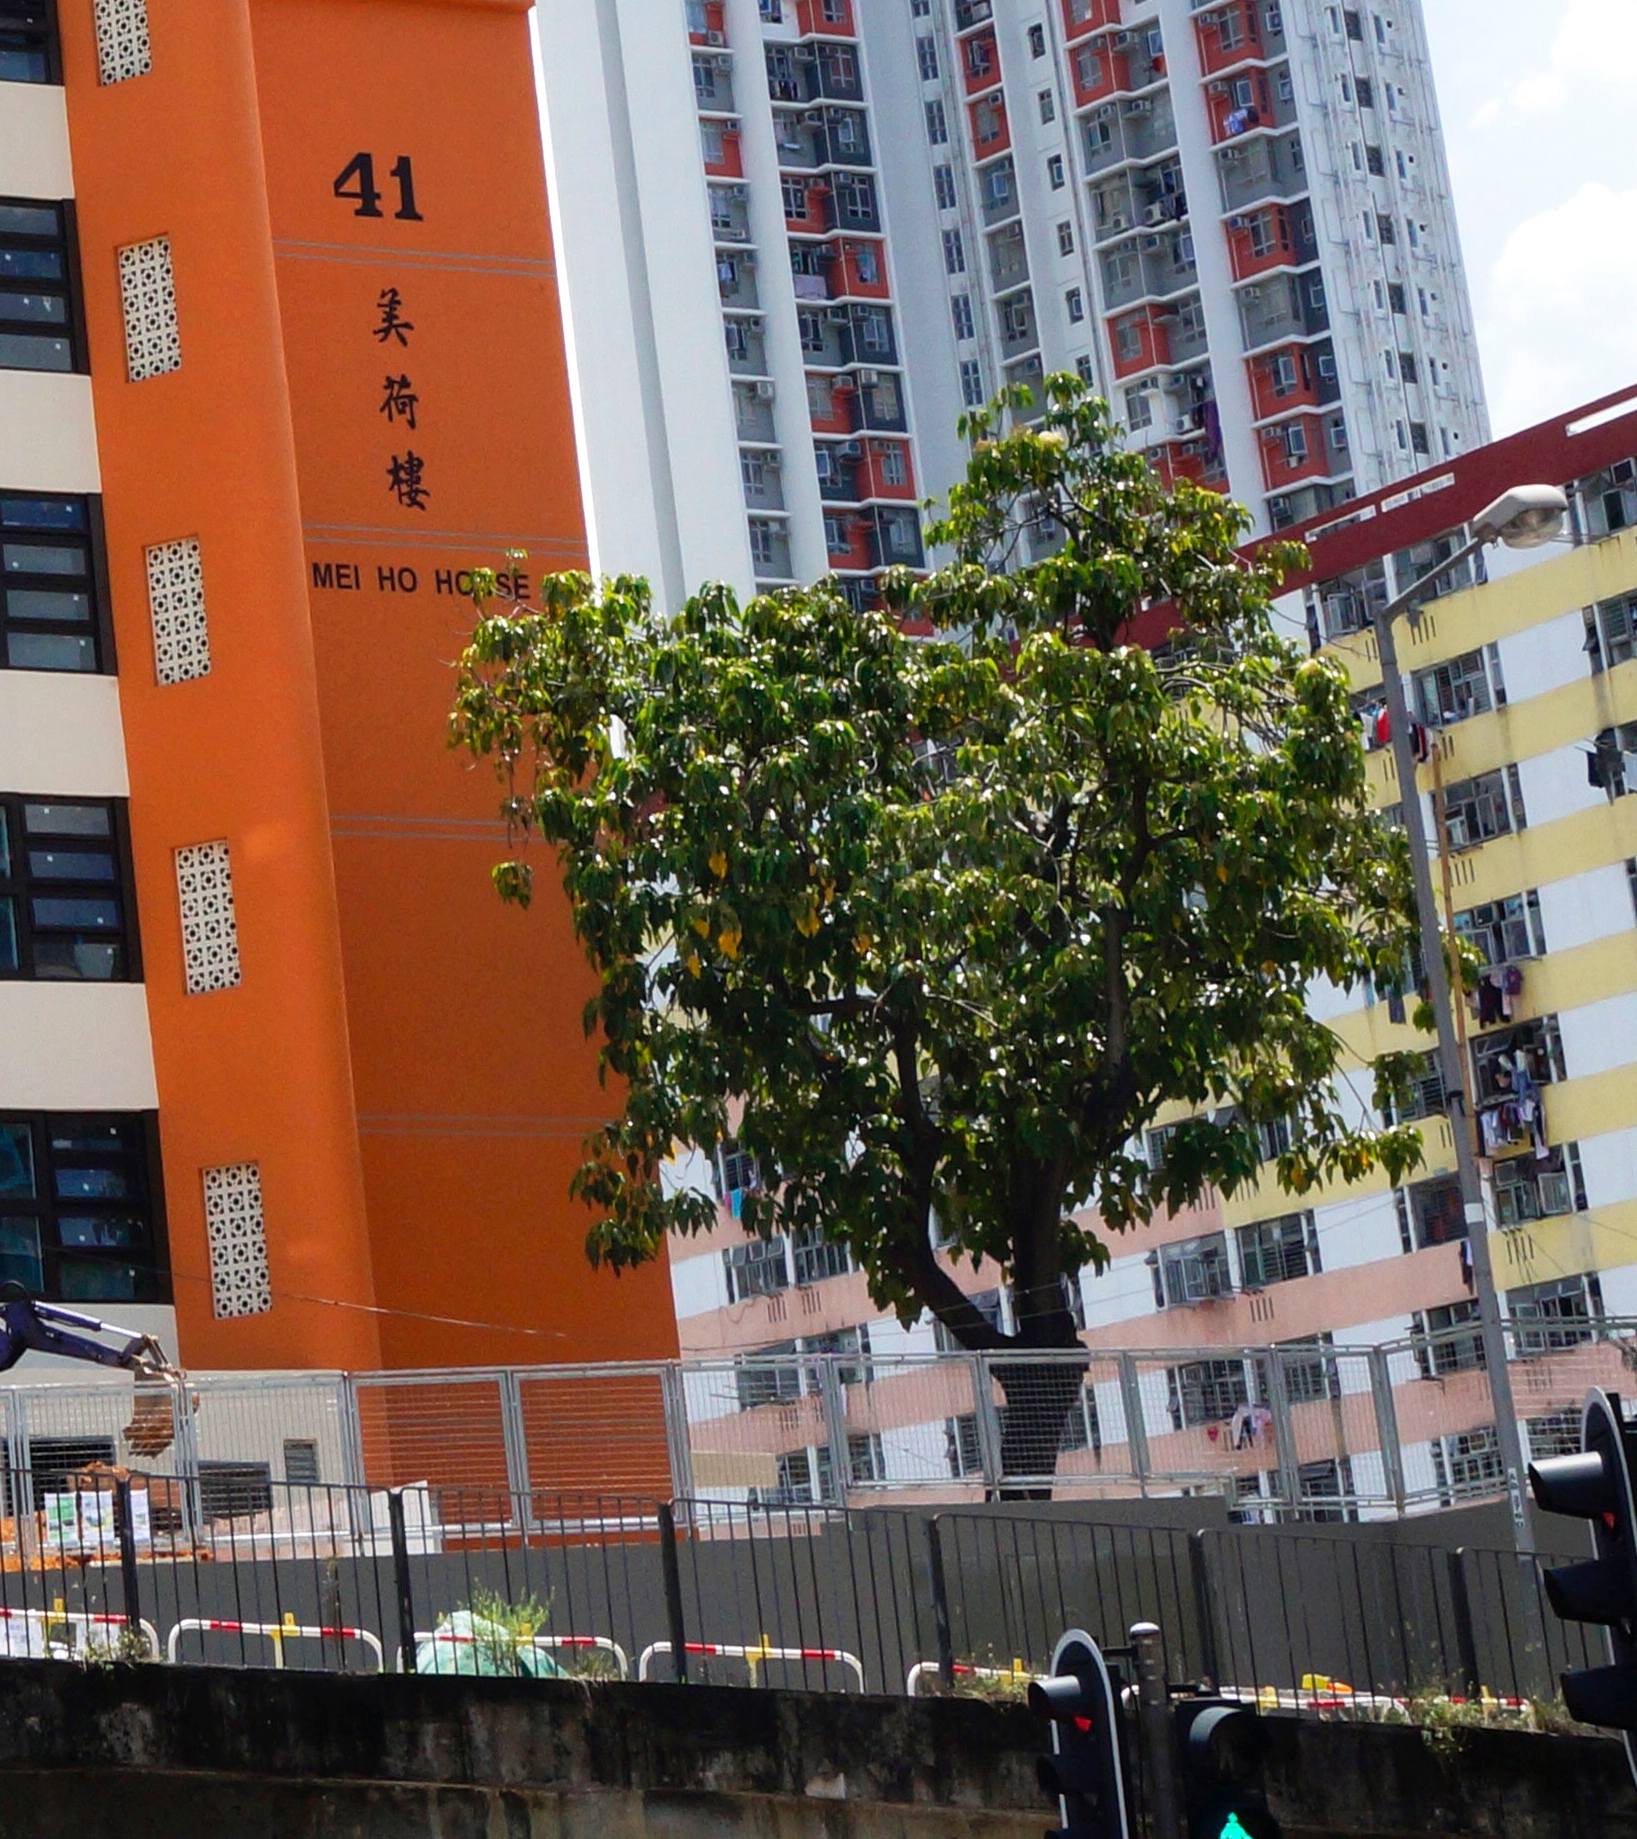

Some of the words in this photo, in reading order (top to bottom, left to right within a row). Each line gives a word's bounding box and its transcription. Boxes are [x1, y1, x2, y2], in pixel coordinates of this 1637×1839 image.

[333, 152, 424, 222] 41
[372, 287, 430, 511] 美荷樓
[312, 562, 361, 590] MEI
[377, 566, 418, 593] HO
[435, 569, 531, 599] HOSE
